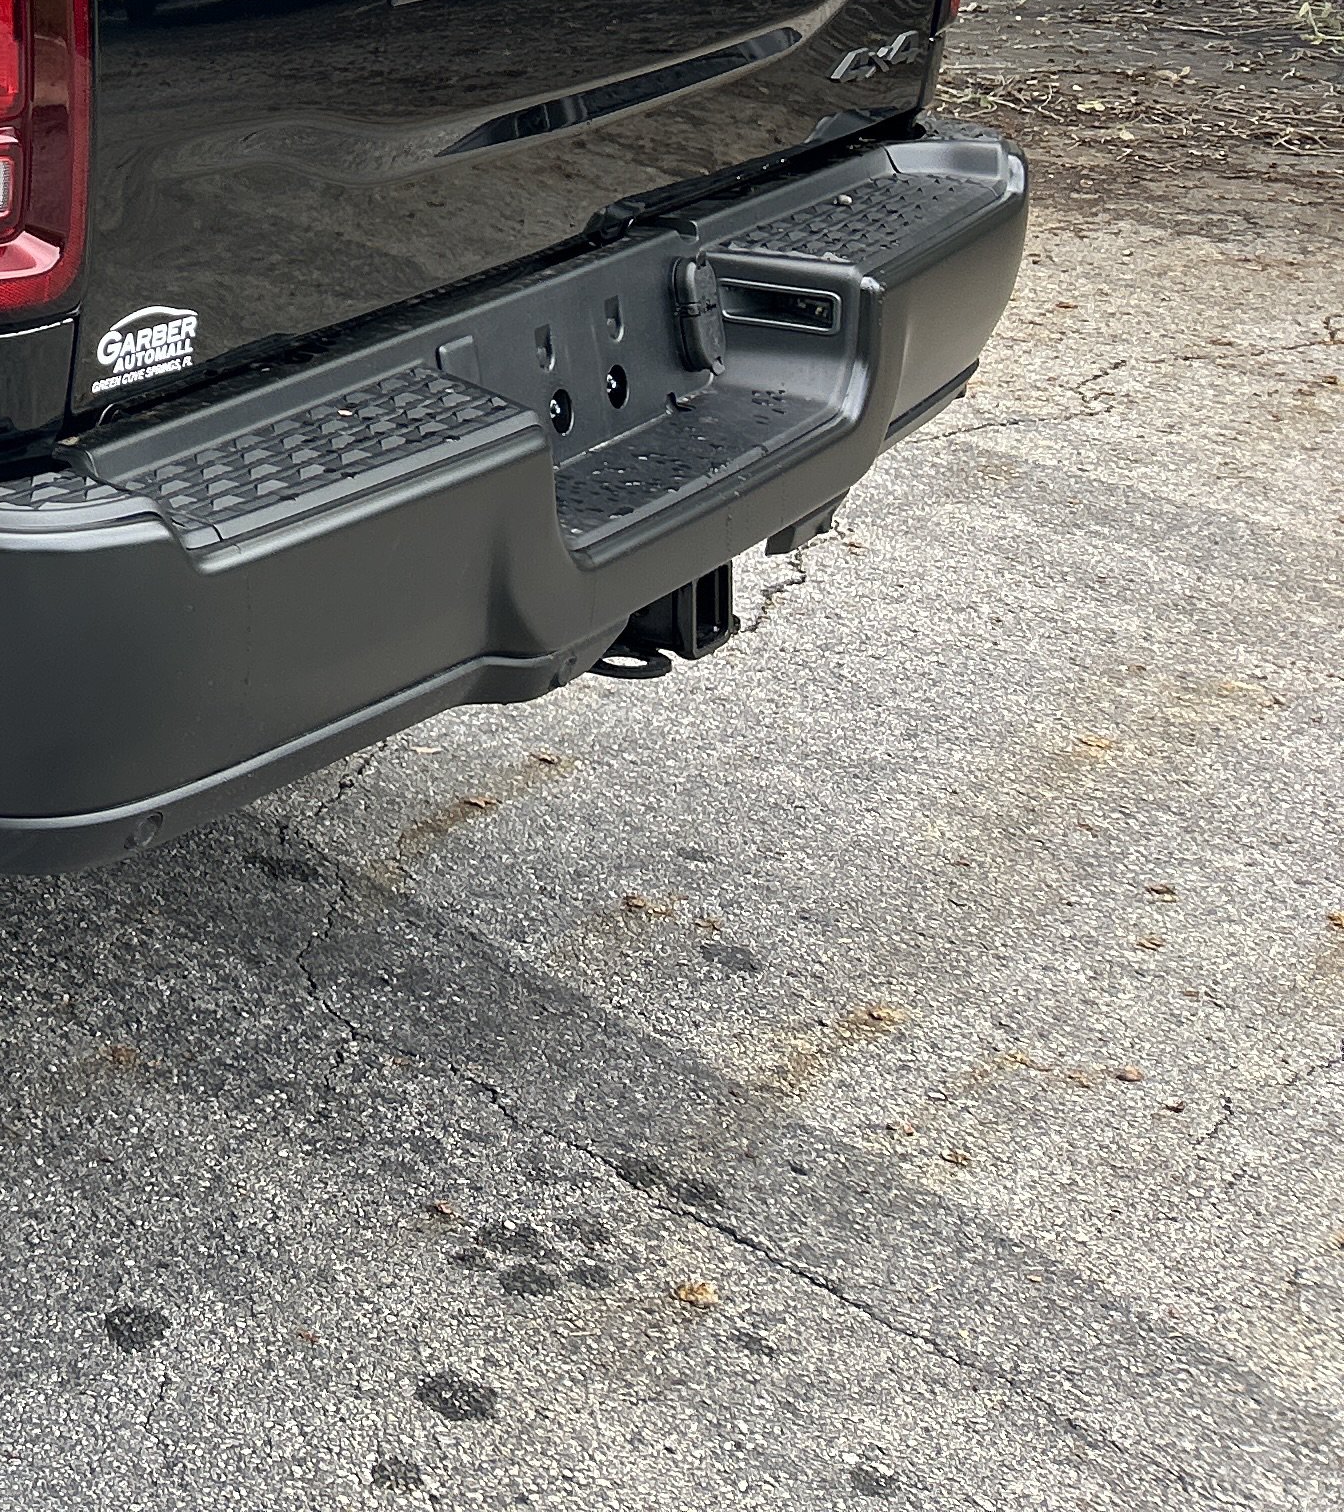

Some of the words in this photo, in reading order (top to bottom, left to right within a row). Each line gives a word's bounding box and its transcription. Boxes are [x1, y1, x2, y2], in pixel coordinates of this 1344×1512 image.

[96, 315, 199, 365] GARBER
[112, 338, 194, 374] AUTOMALL
[91, 375, 122, 394] GREEN
[122, 368, 146, 385] COVE
